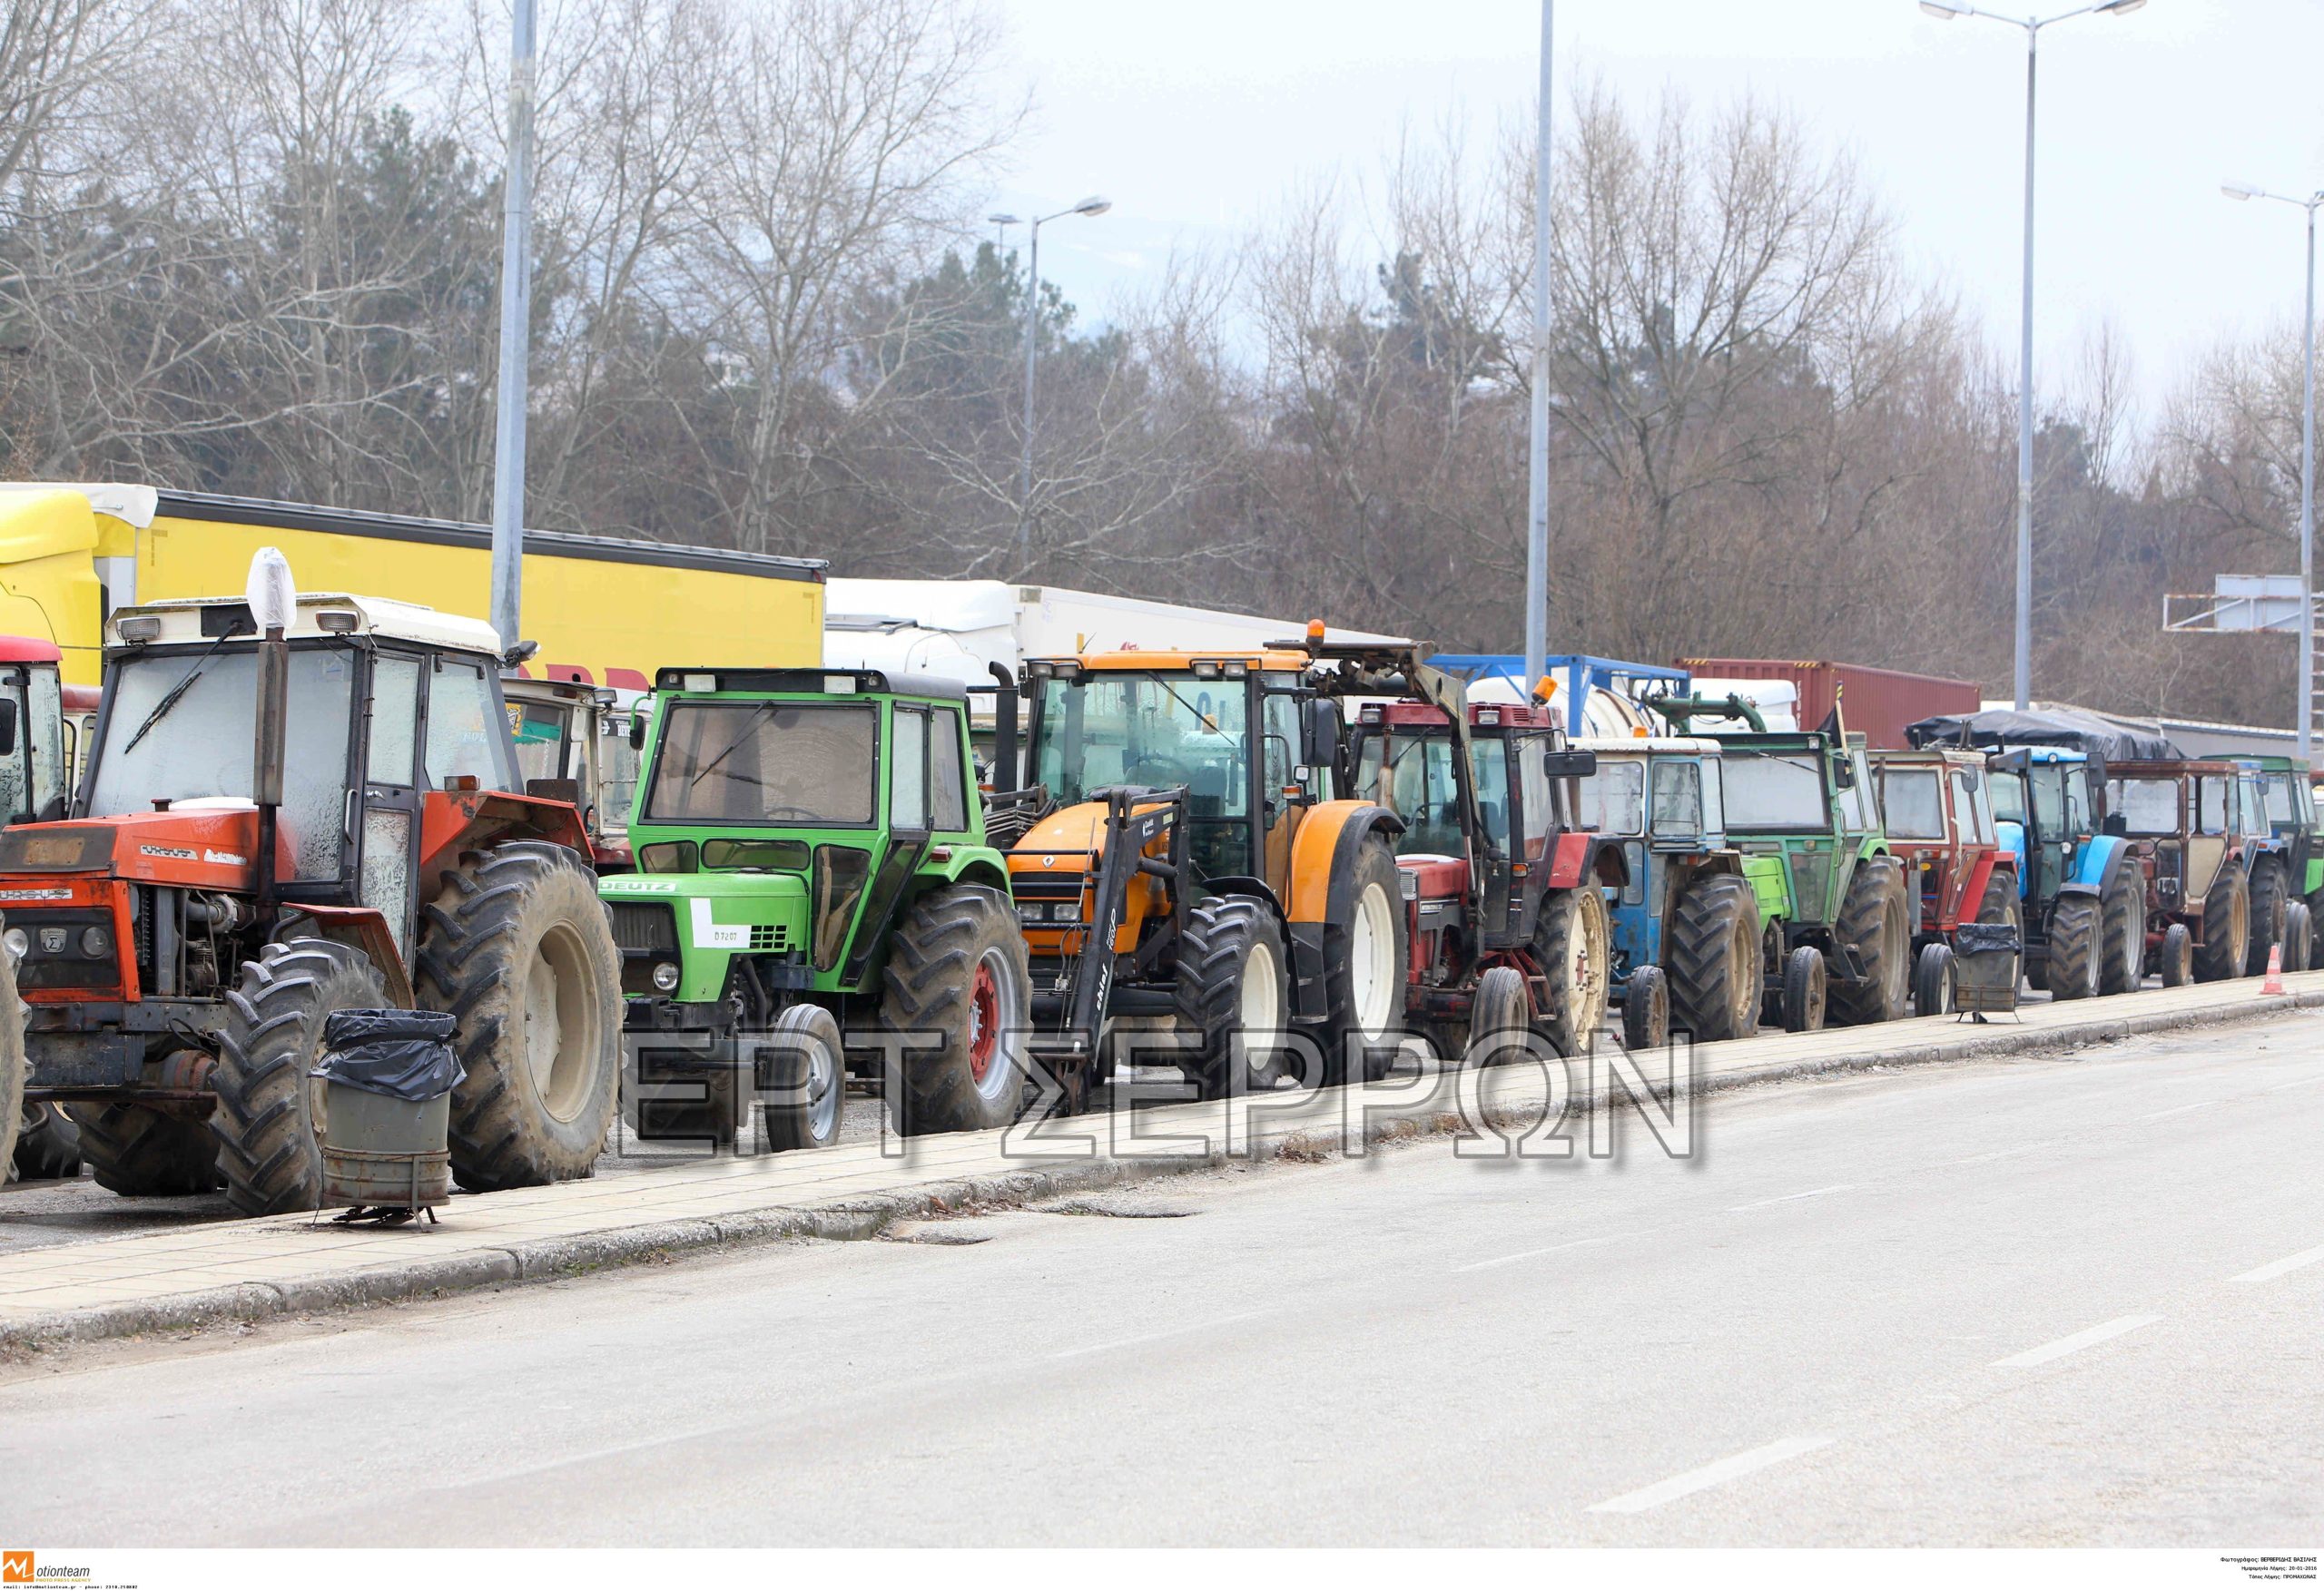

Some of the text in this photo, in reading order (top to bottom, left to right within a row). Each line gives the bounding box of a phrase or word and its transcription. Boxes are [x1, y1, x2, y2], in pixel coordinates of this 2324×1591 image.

[142, 845, 192, 859] URSUS
[599, 881, 672, 890] DEUTZ
[0, 889, 70, 899] URSUS
